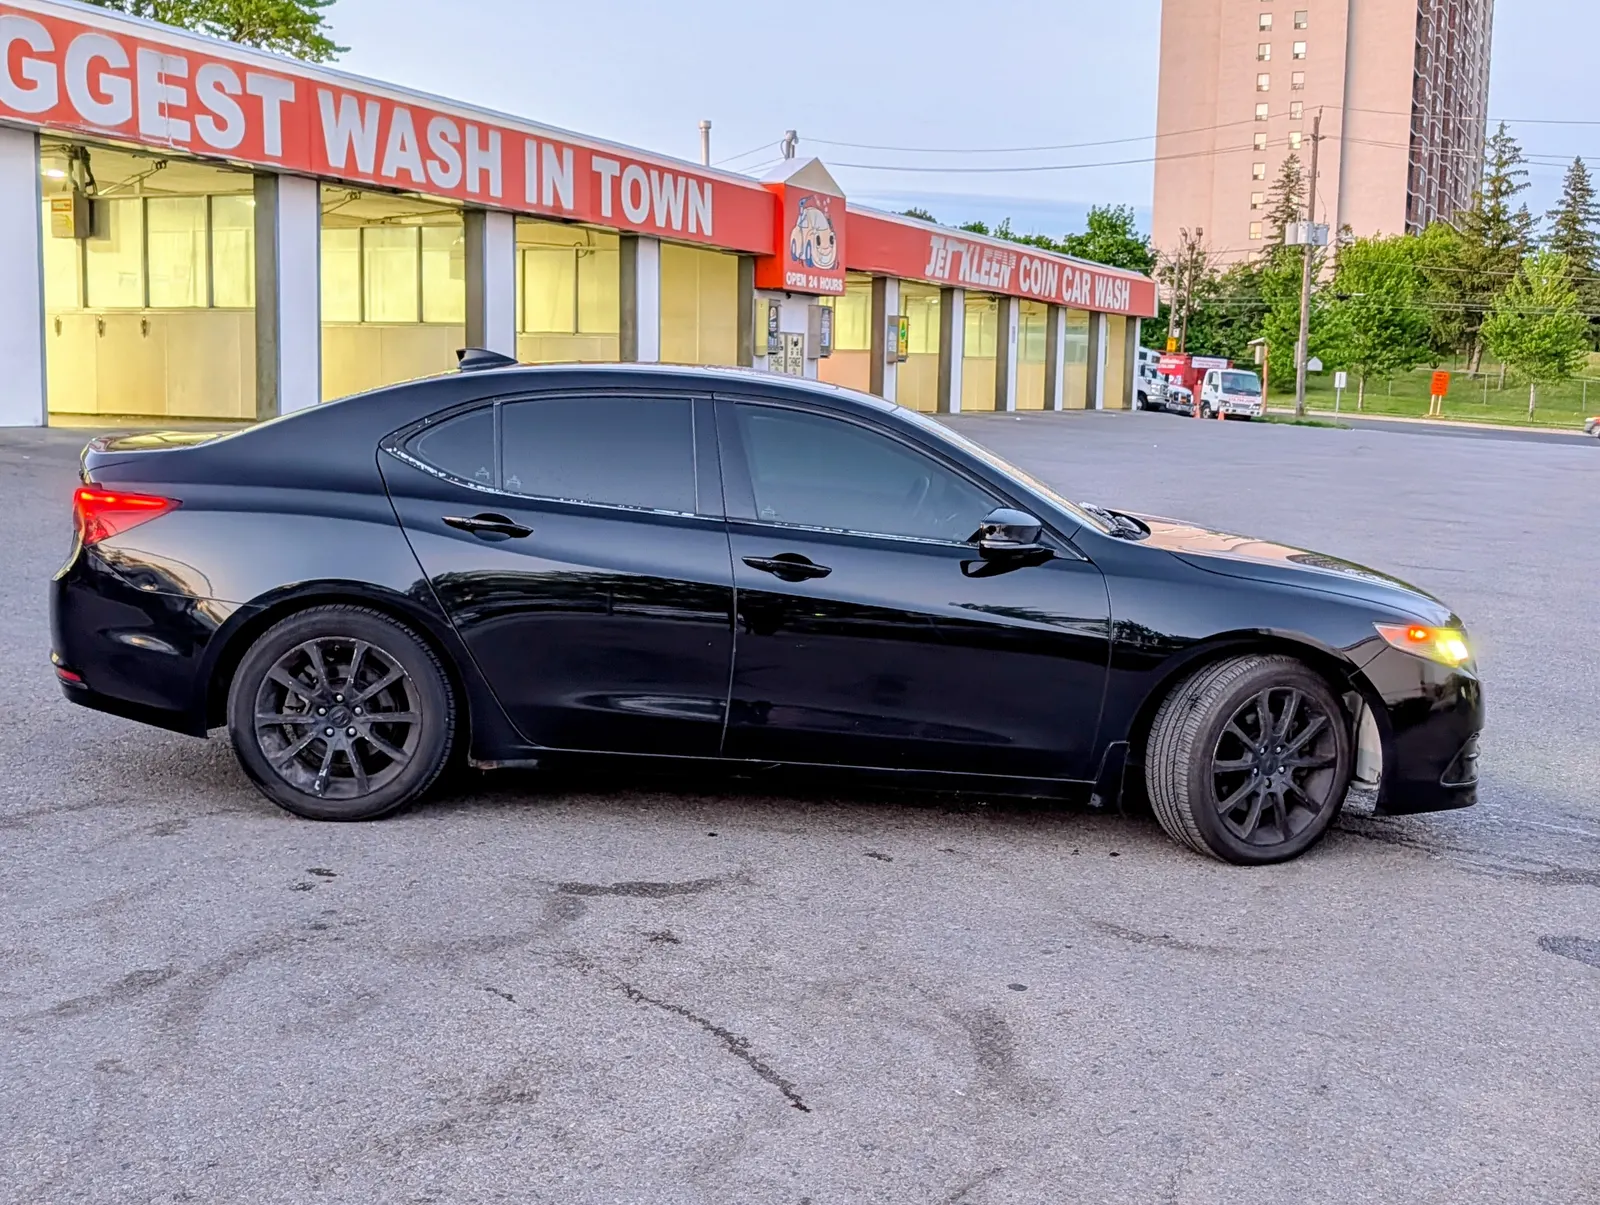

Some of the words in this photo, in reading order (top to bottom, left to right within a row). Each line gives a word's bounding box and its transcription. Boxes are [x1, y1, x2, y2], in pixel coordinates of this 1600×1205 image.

[0, 15, 295, 157] GGEST
[316, 88, 503, 198] WASH
[524, 138, 575, 211] IN
[591, 155, 713, 236] TOWN
[786, 271, 806, 287] OPEN
[808, 275, 818, 288] 24
[820, 276, 843, 292] HOURS
[925, 236, 968, 279] JET
[958, 244, 1017, 289] KLEEN
[1019, 256, 1059, 298] COIN
[1062, 267, 1091, 305] CAR
[1095, 275, 1130, 311] WASH
